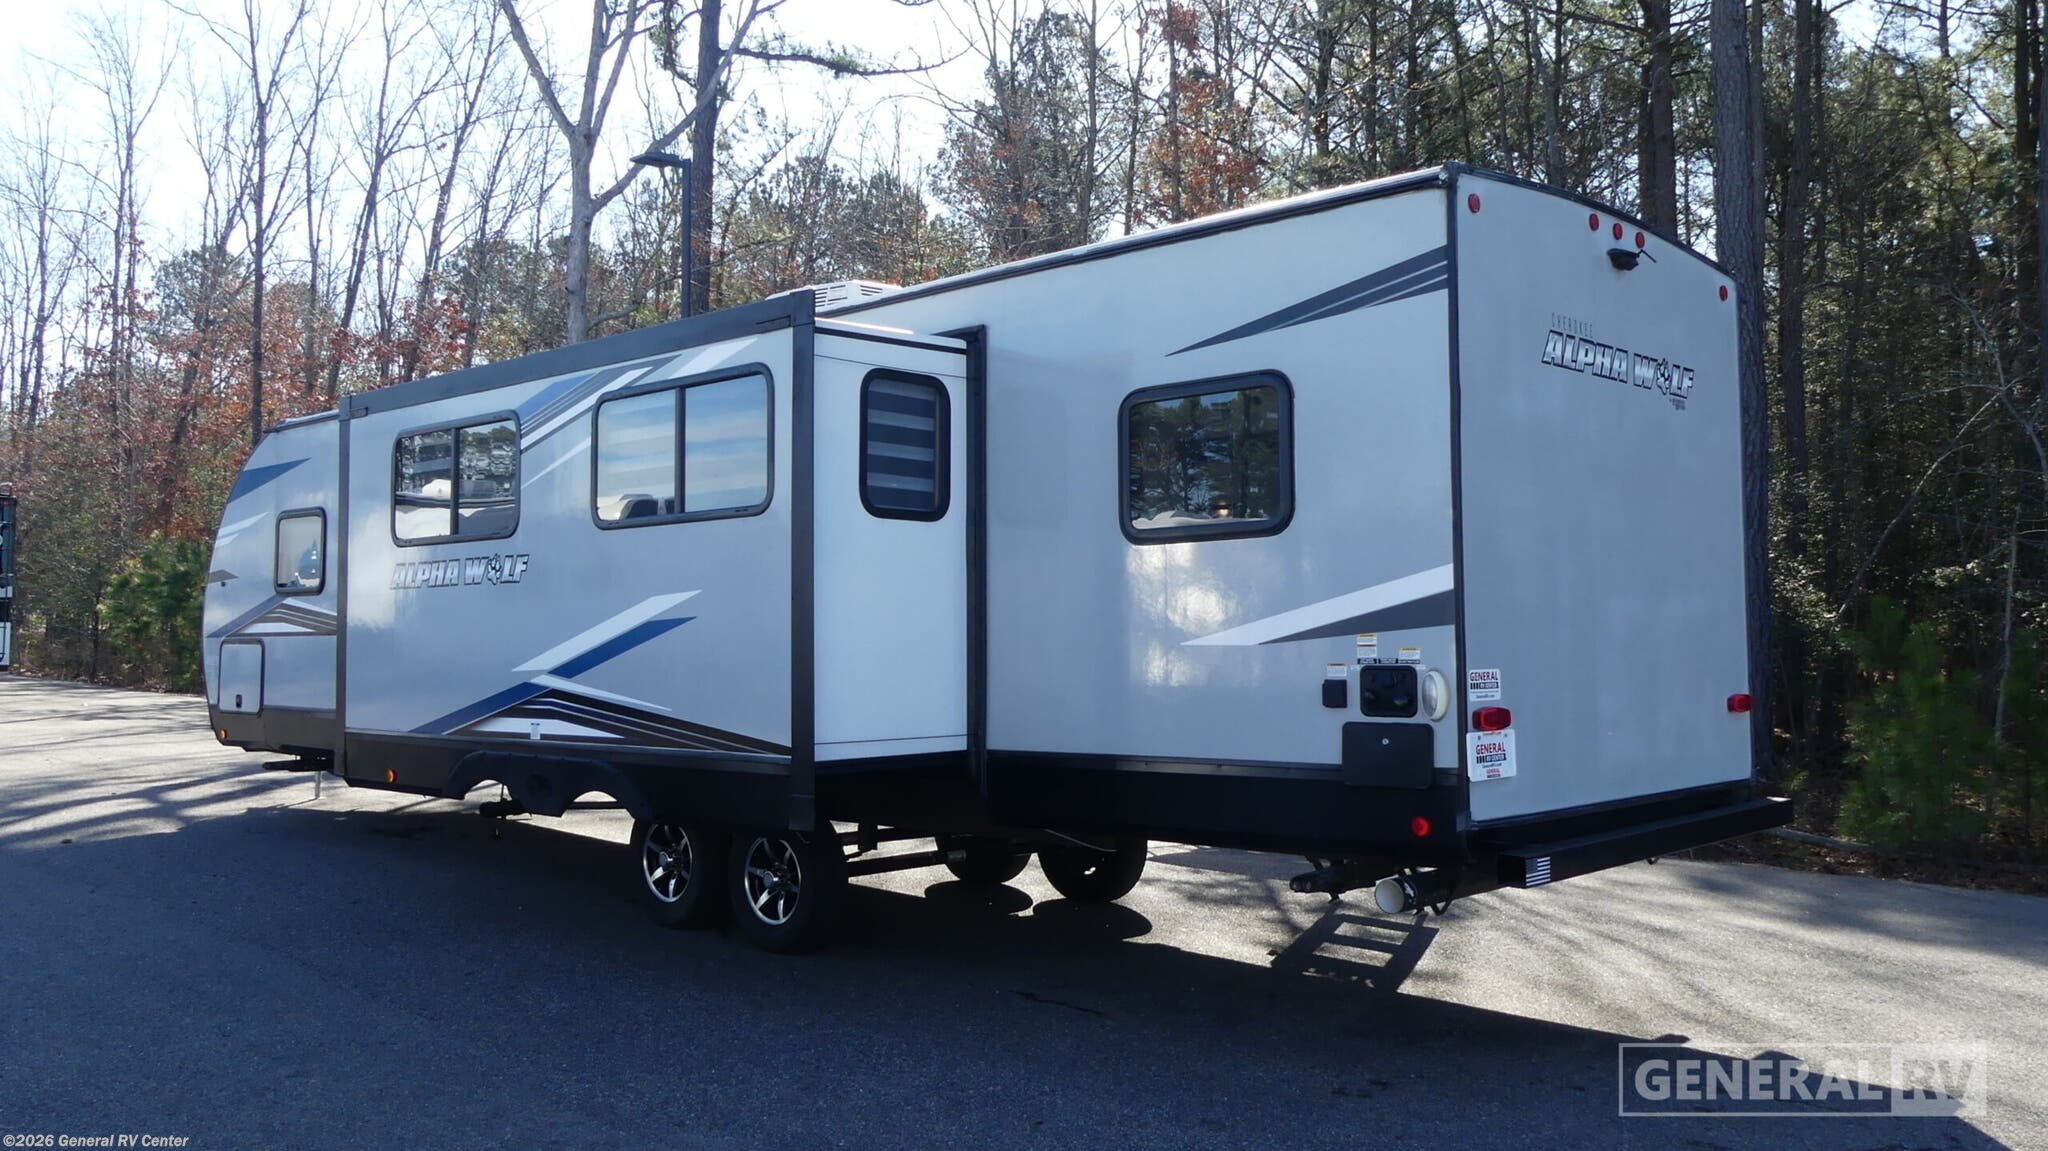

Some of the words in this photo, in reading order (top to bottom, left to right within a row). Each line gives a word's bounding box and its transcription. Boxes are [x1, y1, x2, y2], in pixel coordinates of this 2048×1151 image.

[1541, 329, 1629, 384] ALPHA
[390, 559, 461, 590] ALPHA
[1470, 671, 1499, 682] GENERAL
[1476, 742, 1506, 755] GENERAL
